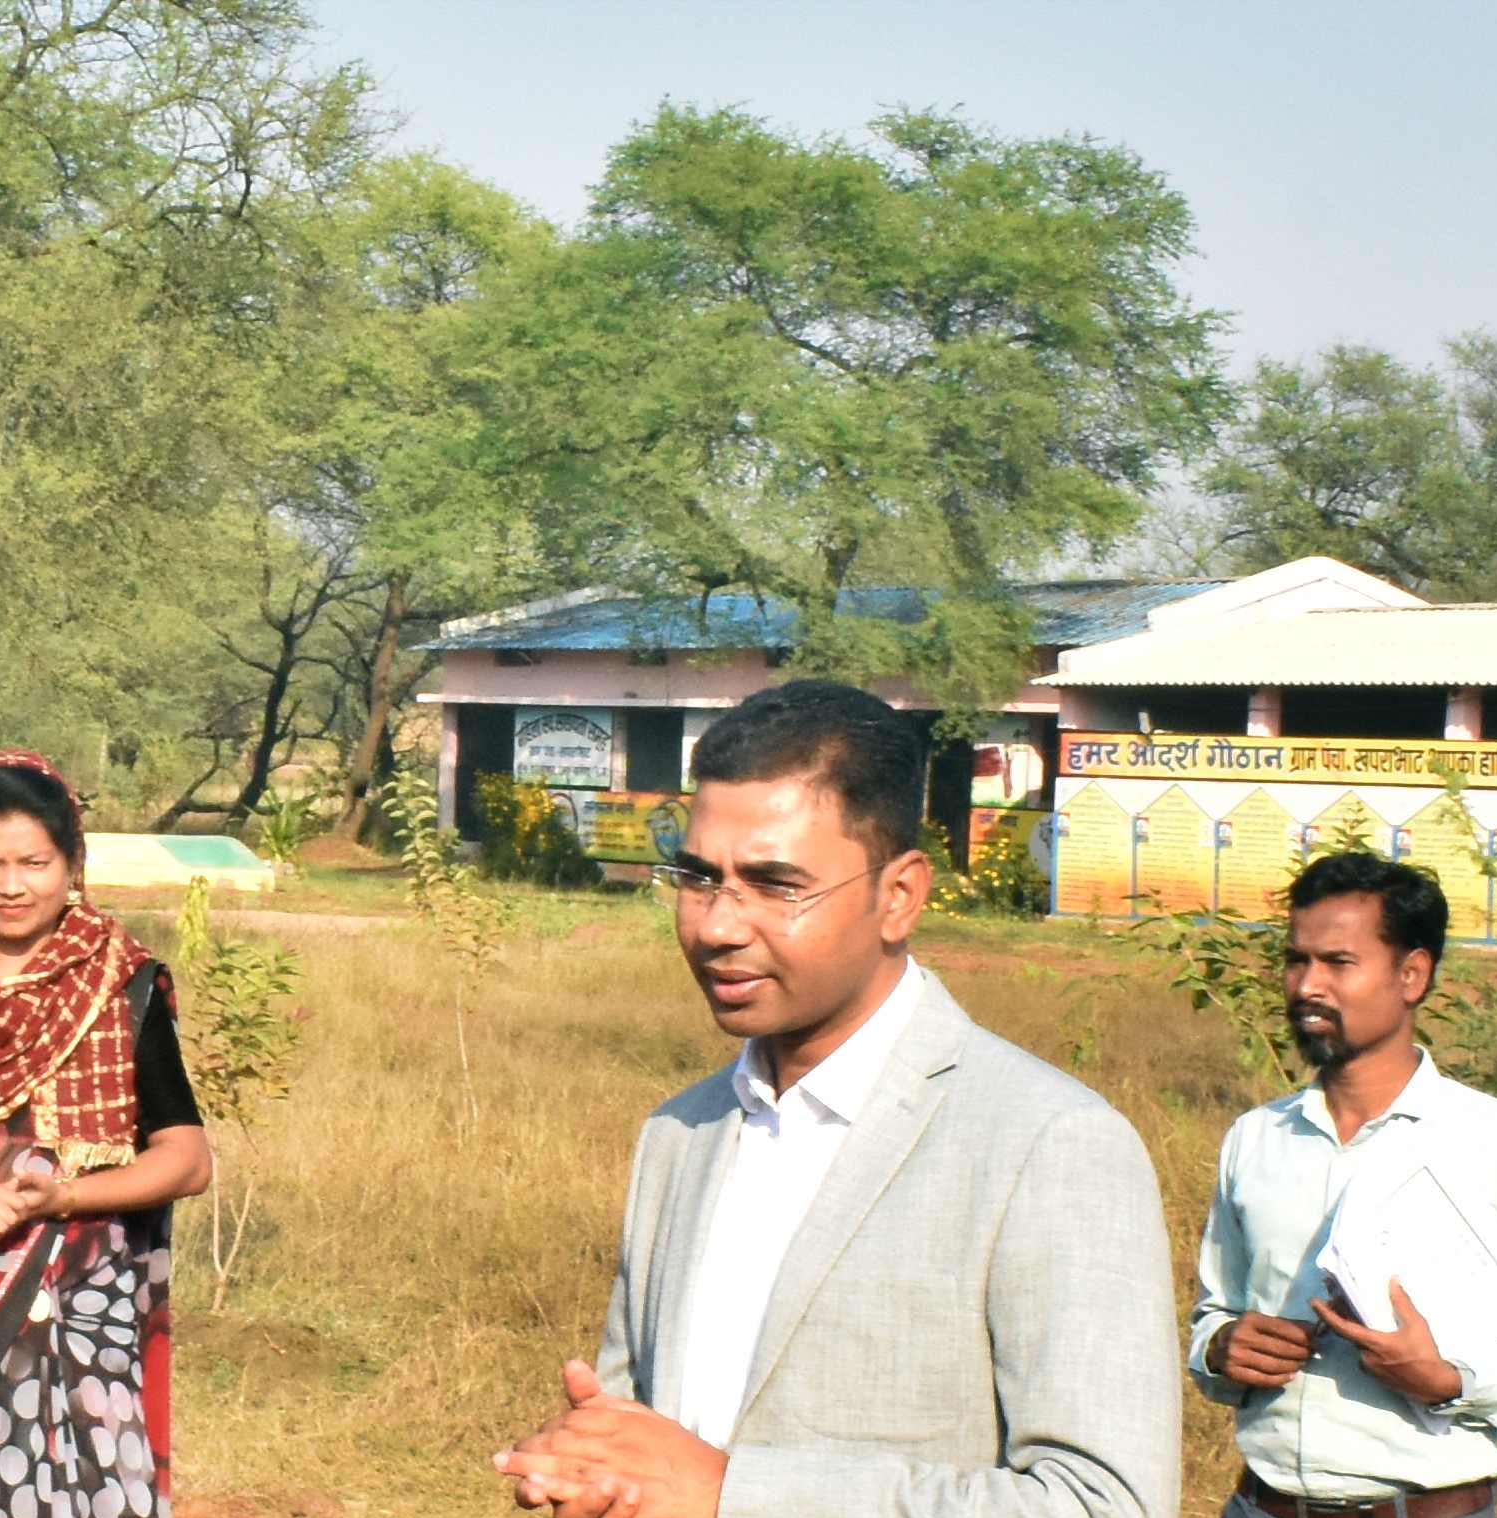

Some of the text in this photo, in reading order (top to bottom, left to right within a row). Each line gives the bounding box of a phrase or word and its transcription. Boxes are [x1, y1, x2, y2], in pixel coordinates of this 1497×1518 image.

[1068, 741, 1120, 770] हमर
[1127, 738, 1200, 772] आदर्श
[1207, 738, 1285, 769] गौठान
[1291, 747, 1318, 773] ग्राम
